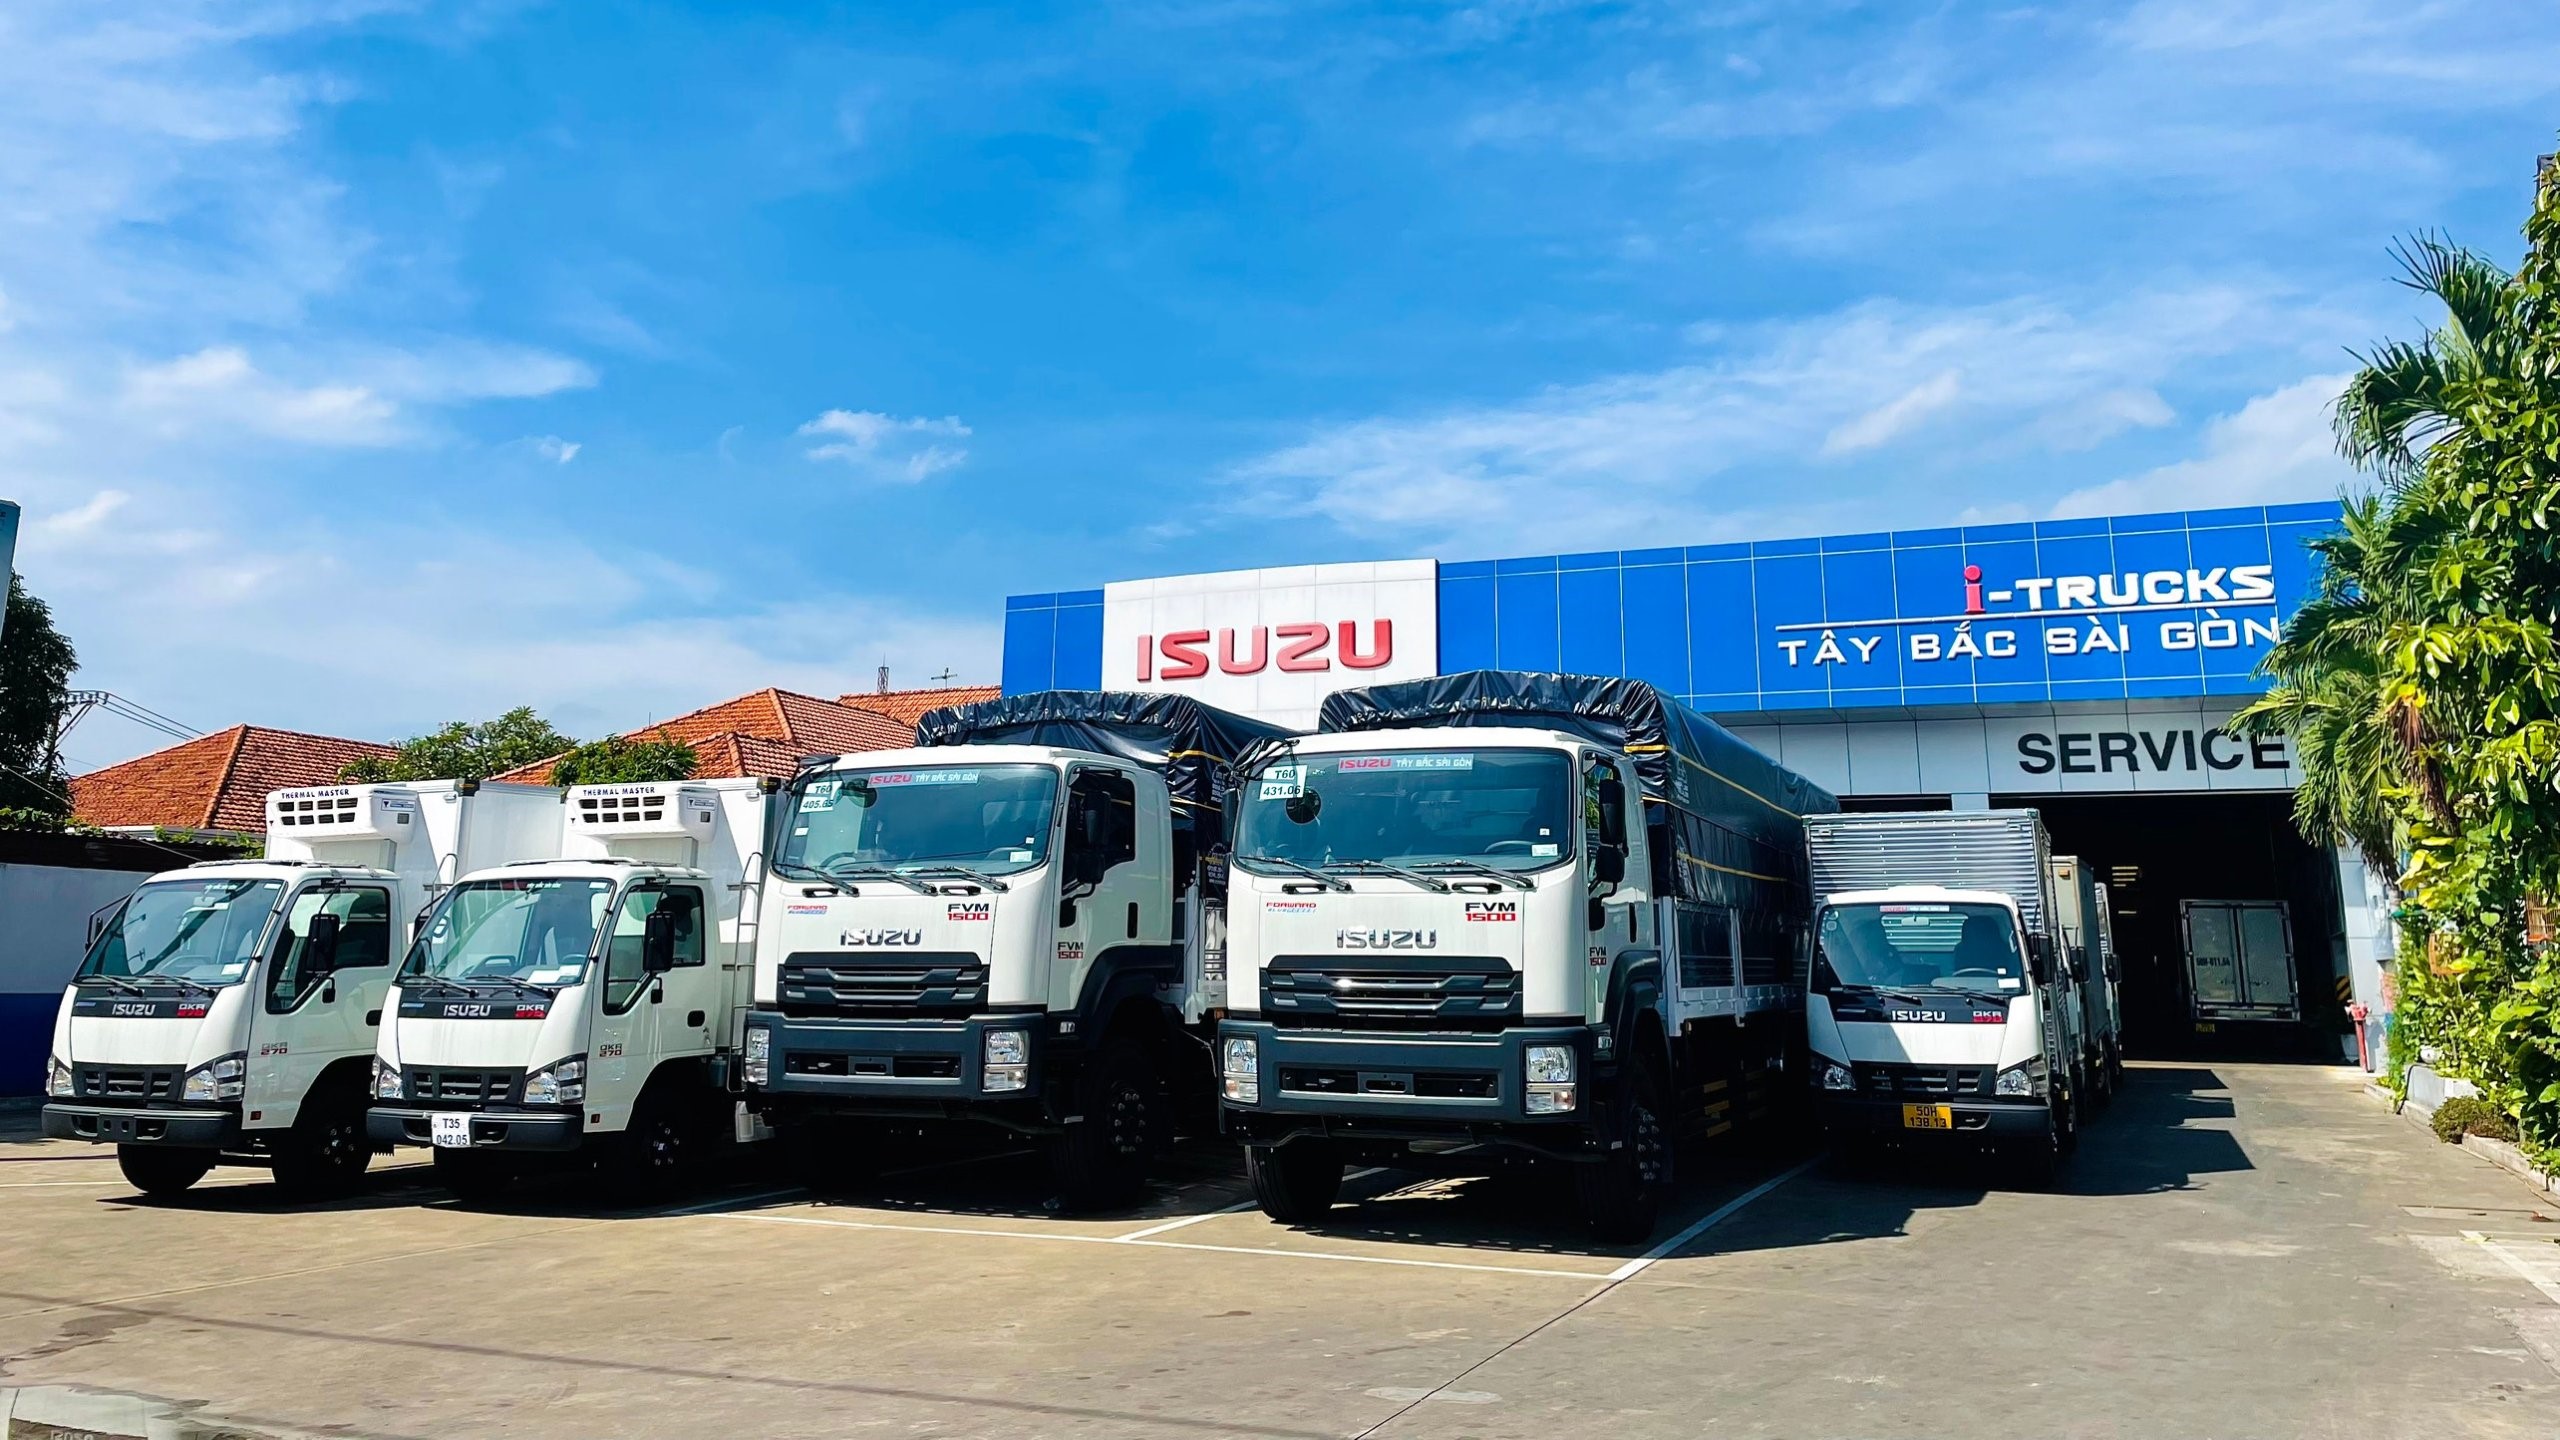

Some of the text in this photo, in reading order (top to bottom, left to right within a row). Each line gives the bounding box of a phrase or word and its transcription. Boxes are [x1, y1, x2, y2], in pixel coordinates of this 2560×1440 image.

[1963, 564, 2276, 614] i-TRUCKS
[1777, 608, 2279, 666] TÂY BẮC SÀI GÒN
[1136, 617, 1393, 683] ISUZU
[2017, 727, 2291, 775] SERVICE
[1340, 754, 1473, 769] ISUZU TÂY BẮC SÀI GÒN
[870, 773, 912, 784] ISUZU
[1274, 769, 1296, 780] T60
[281, 788, 350, 799] THERMAL MASTER
[583, 786, 655, 797] THERMAL MASTER
[815, 784, 832, 794] T60
[1263, 785, 1301, 796] 431.06
[947, 903, 989, 912] FVM
[1465, 902, 1516, 912] FVM
[947, 912, 989, 921] 1500
[1465, 912, 1516, 922] 1500
[840, 927, 922, 946] ISUZU
[1336, 928, 1437, 949] ISUZU
[1057, 941, 1084, 950] FVM
[1057, 950, 1084, 959] 1500
[112, 1003, 157, 1016] ISUZU
[443, 1004, 491, 1017] ISUZU
[1891, 1010, 1946, 1022] ISUZU
[1915, 1105, 1937, 1117] 50H
[442, 1117, 461, 1129] T35
[436, 1134, 468, 1146] 042.05
